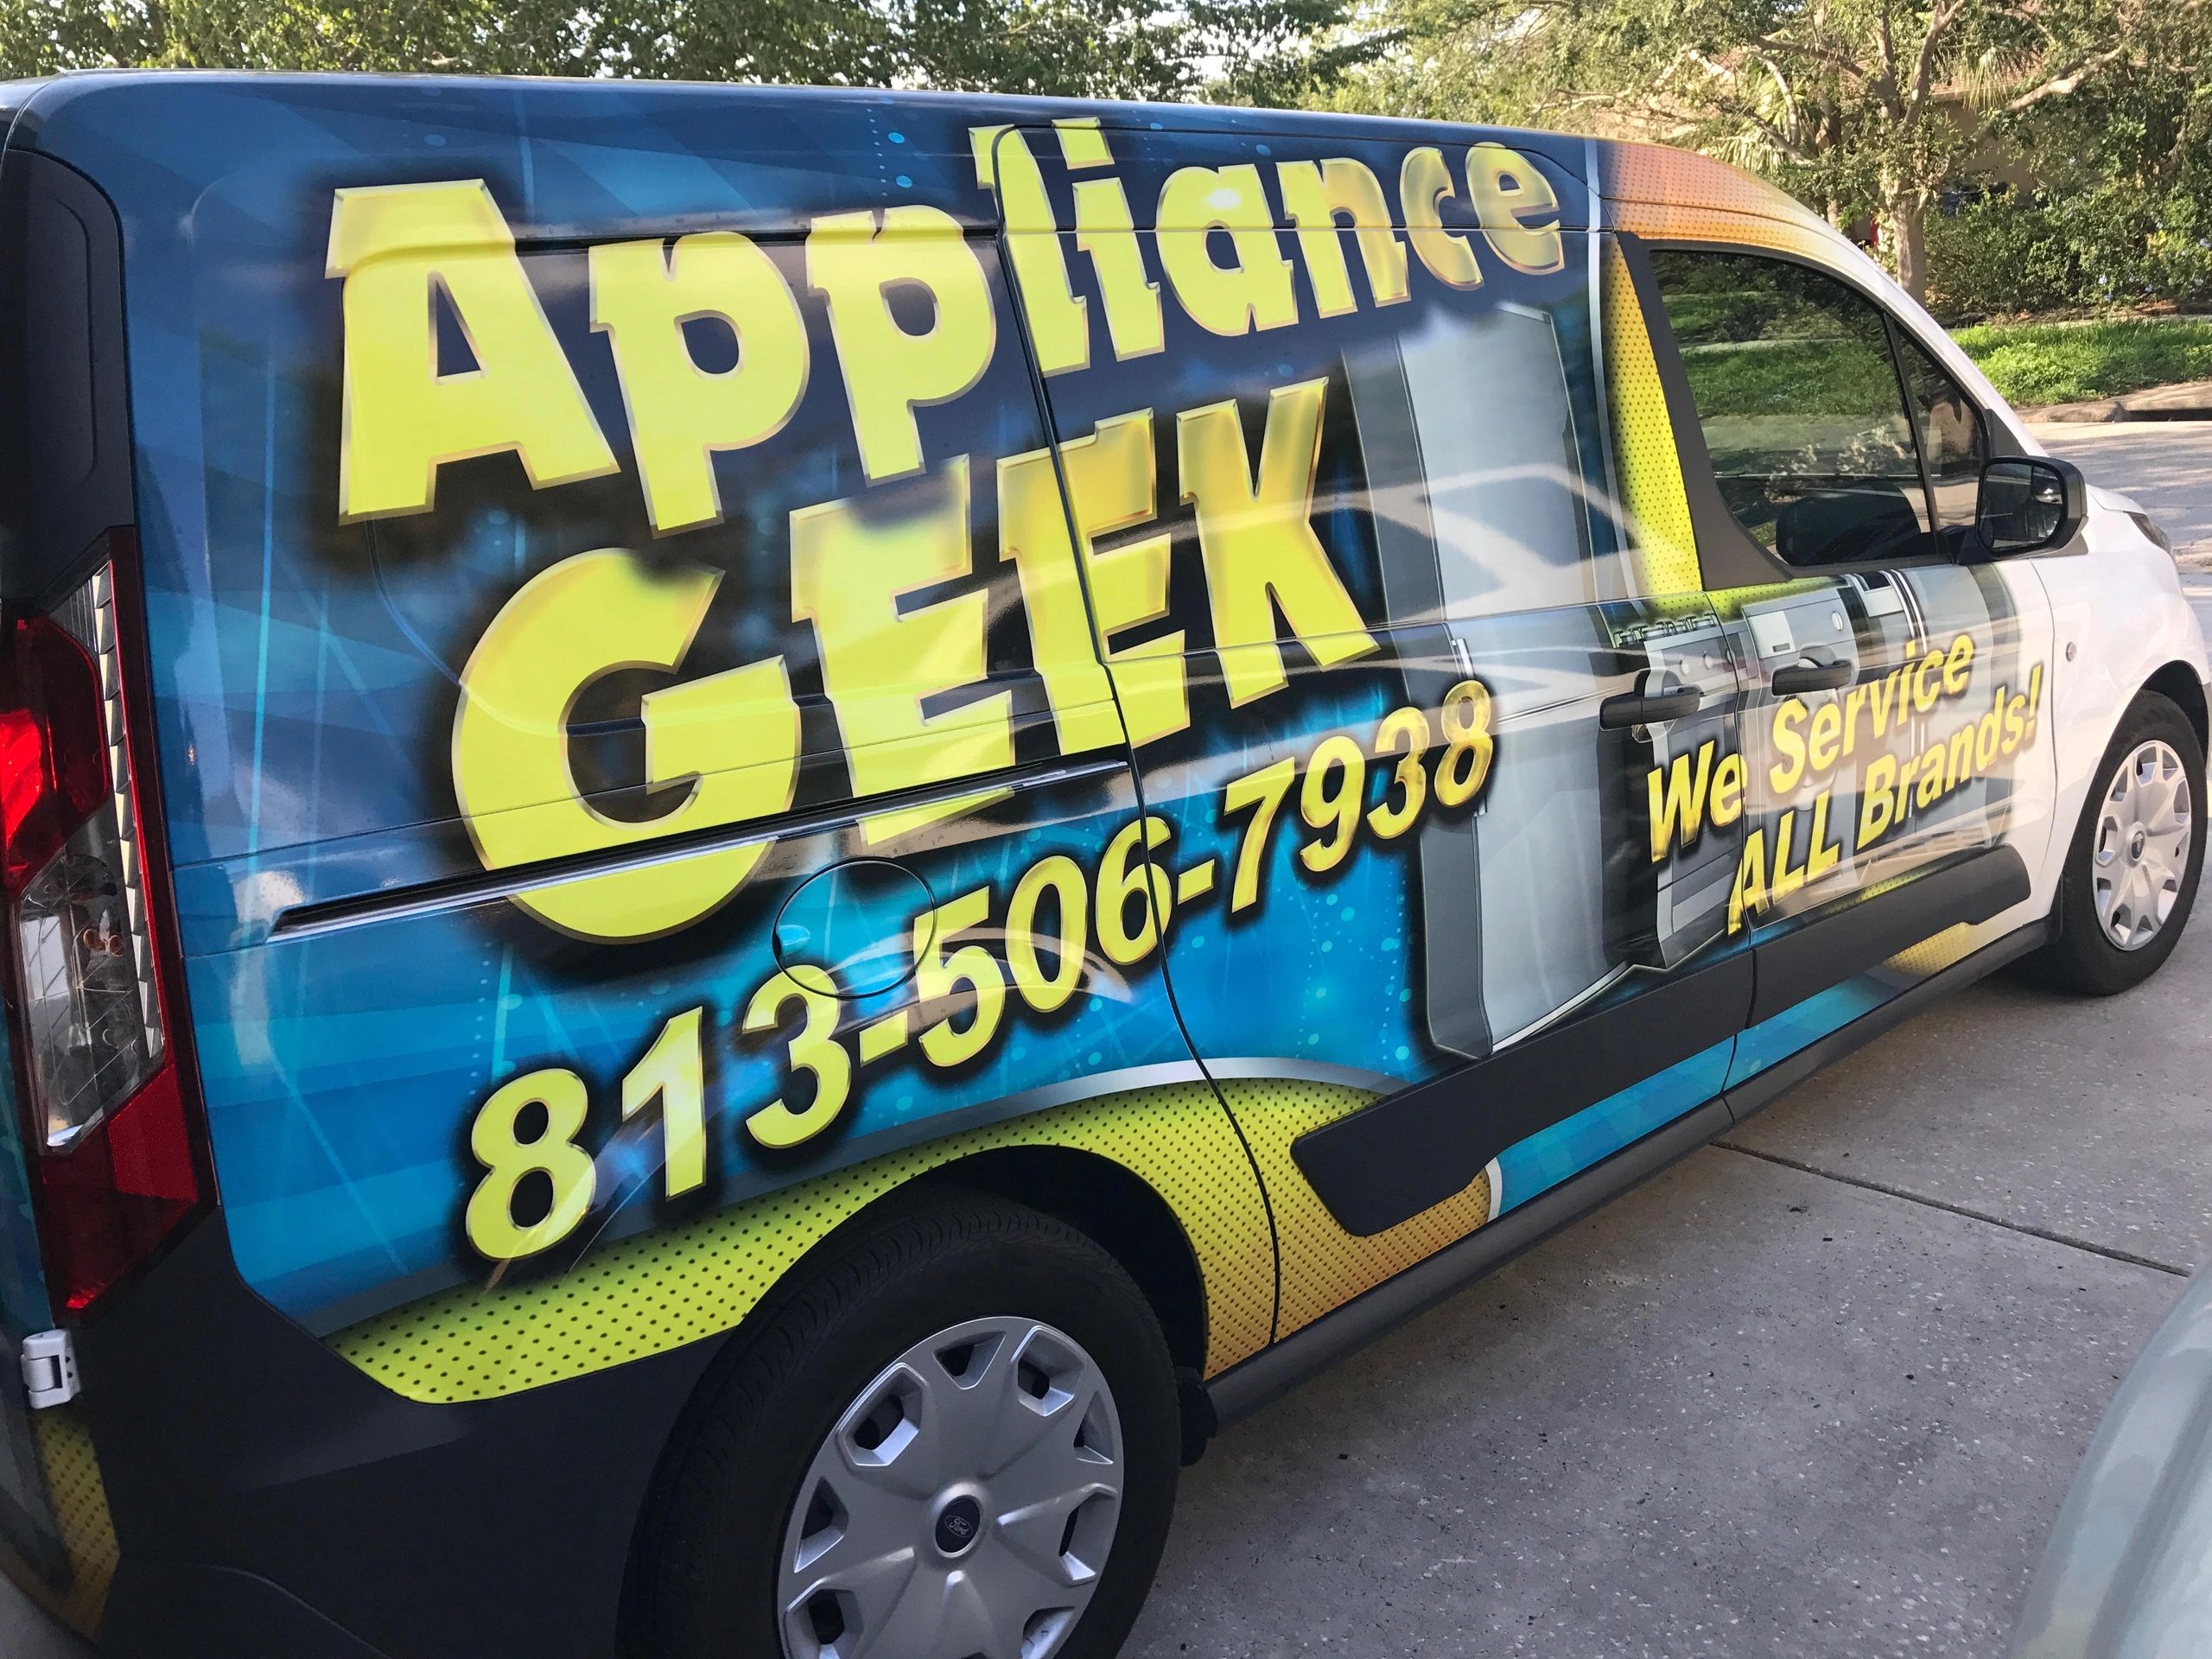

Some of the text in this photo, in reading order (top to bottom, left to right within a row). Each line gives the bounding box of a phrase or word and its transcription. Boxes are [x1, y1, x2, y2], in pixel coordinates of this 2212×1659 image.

[325, 118, 1566, 533] Appliance
[450, 377, 1379, 943] GEEK
[1647, 634, 1974, 863] We Service
[1728, 665, 2043, 934] ALL Brands!
[465, 680, 1496, 1262] 813-506-7938
[950, 1518, 969, 1535] Ford
